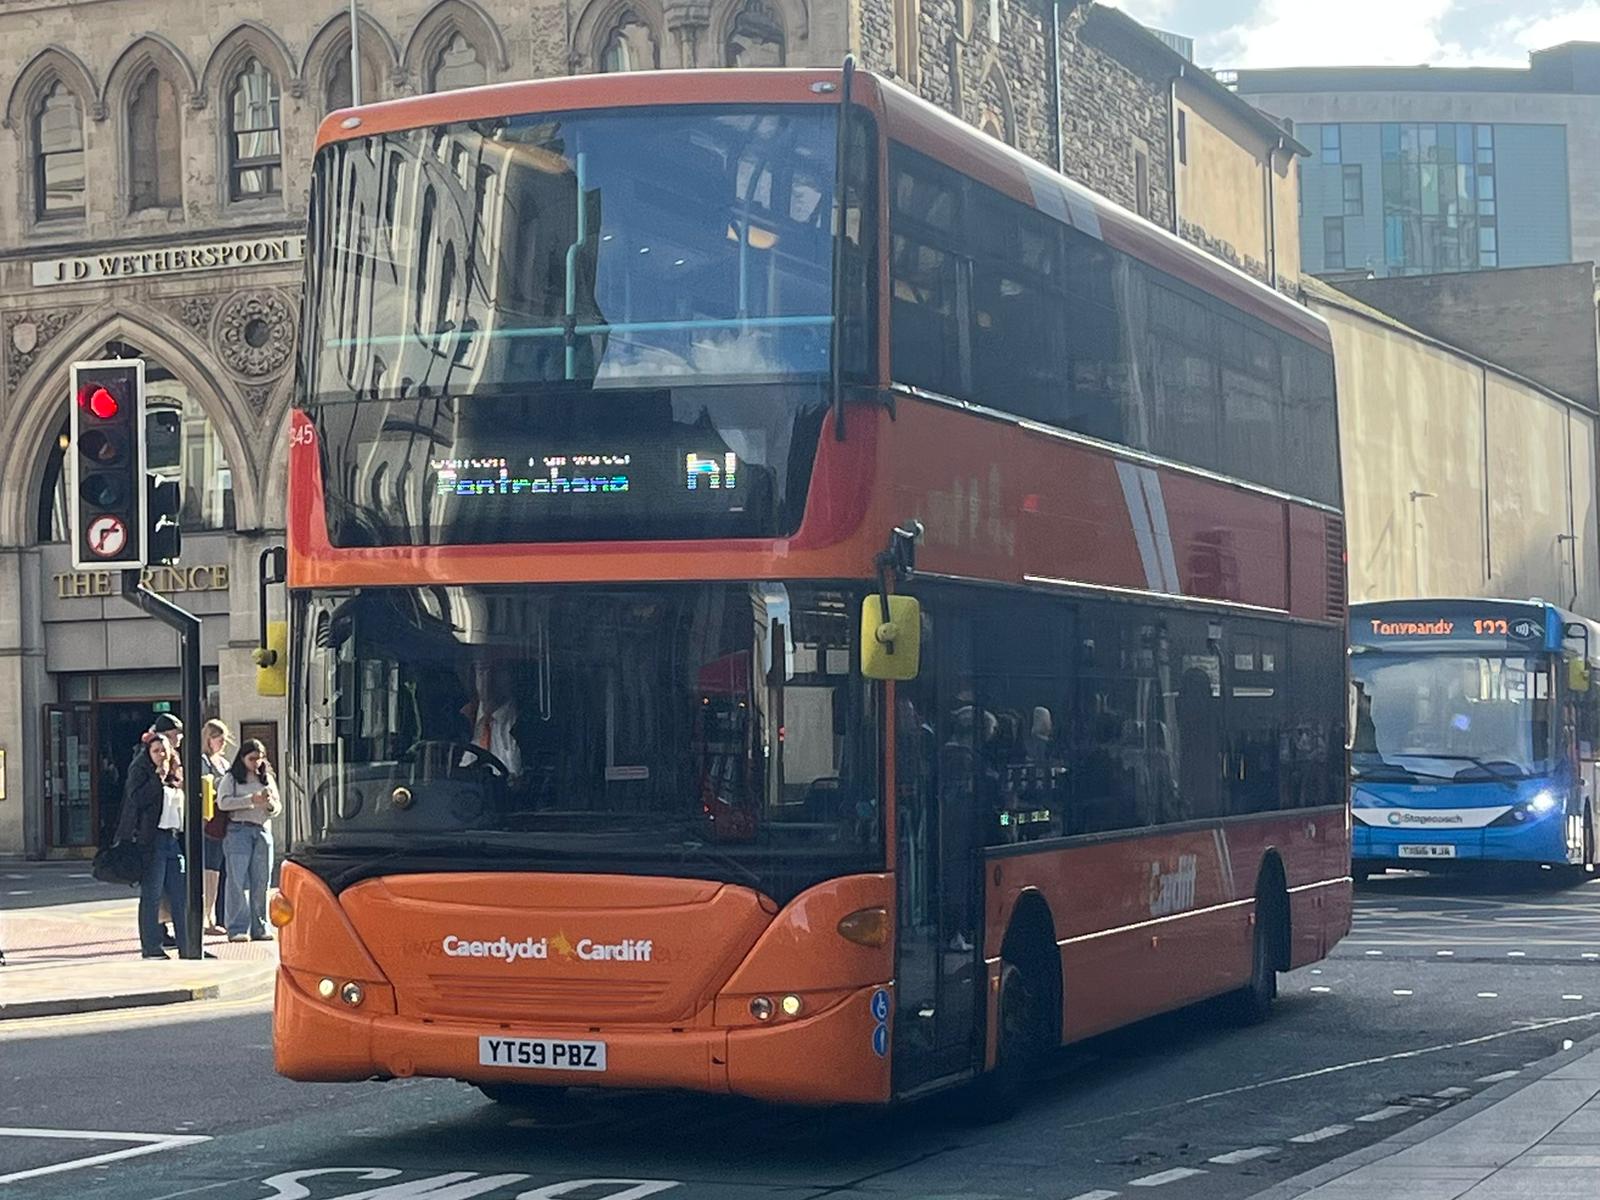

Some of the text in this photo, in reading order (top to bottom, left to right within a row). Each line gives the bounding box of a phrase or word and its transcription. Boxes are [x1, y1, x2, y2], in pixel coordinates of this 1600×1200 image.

[99, 240, 289, 276] WETHERSPOON
[54, 564, 229, 598] THE RINCE
[1371, 618, 1453, 636] Tonypandy
[1402, 813, 1464, 825] Stagecoach
[442, 935, 548, 963] Caerdydd
[576, 938, 653, 962] Cardiff
[488, 1040, 598, 1067] YT59 PBZ
